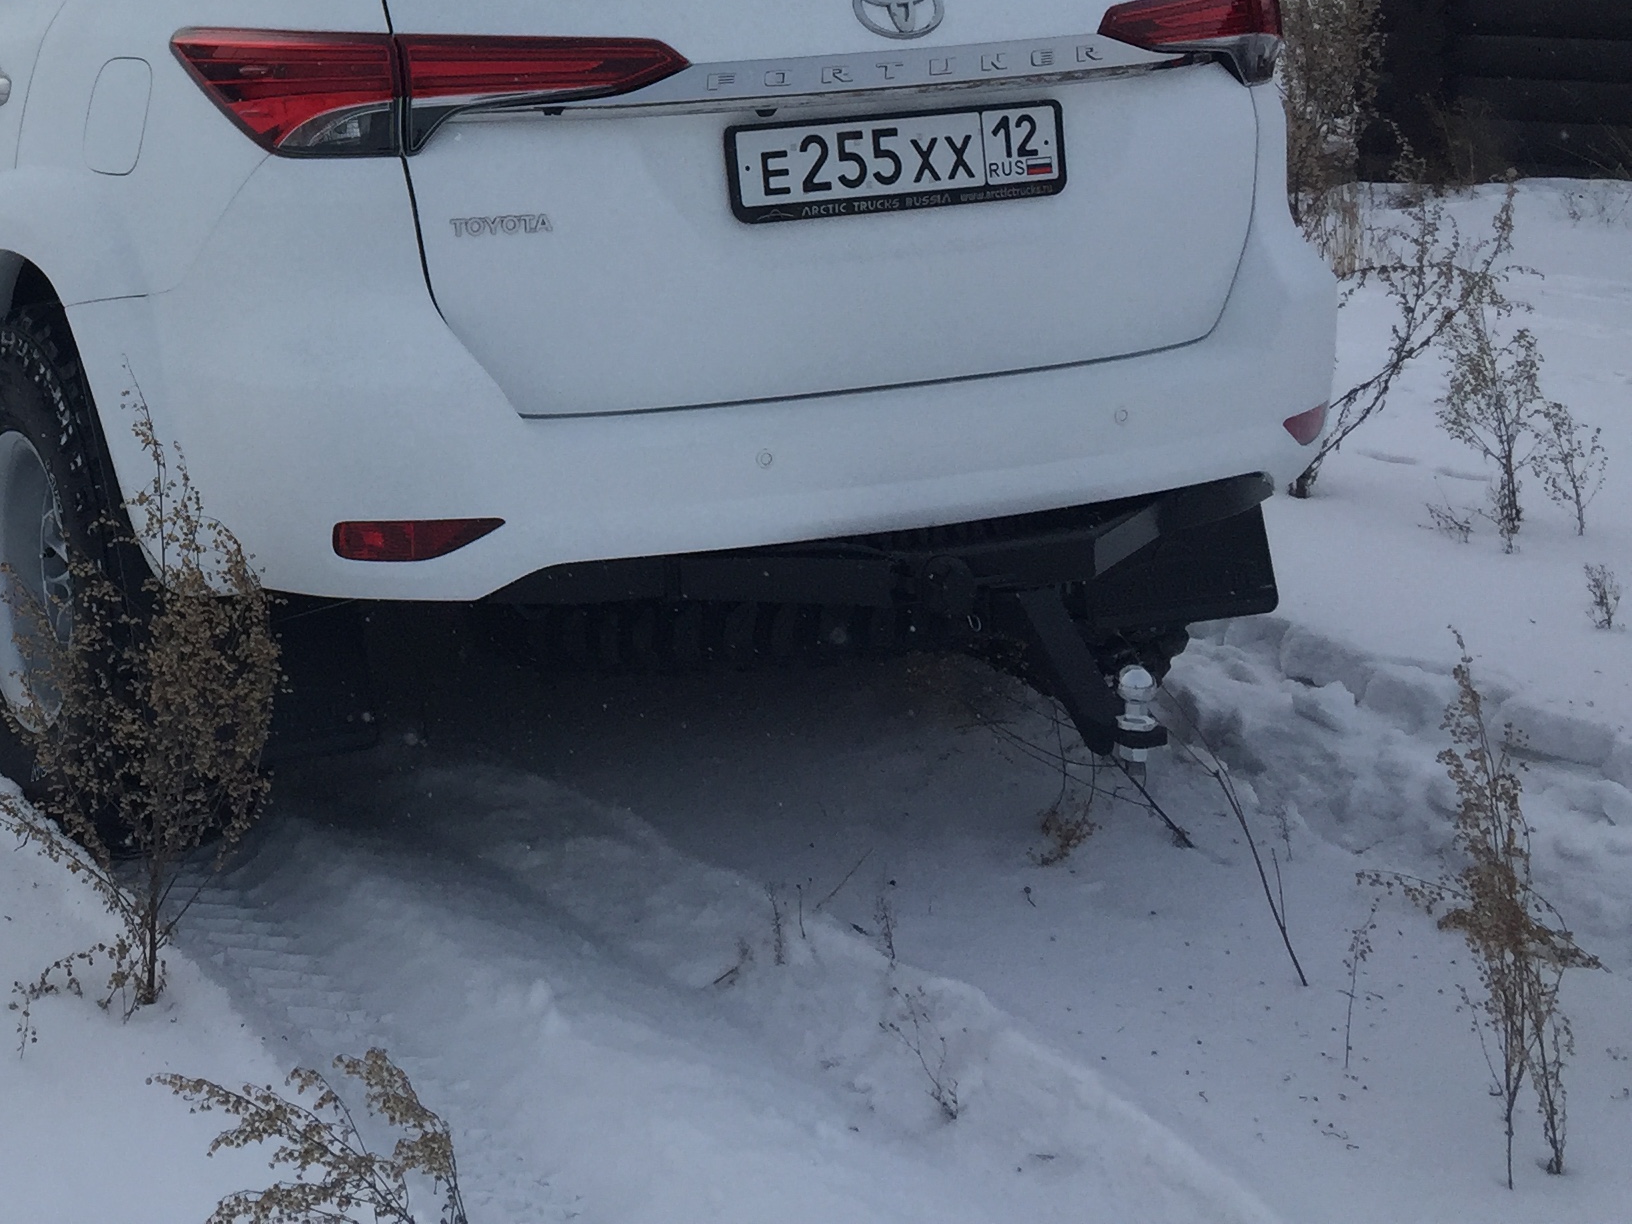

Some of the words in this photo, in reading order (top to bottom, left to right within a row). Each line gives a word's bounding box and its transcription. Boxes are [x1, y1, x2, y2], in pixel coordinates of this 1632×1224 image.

[707, 45, 1103, 90] FORTUNER
[990, 114, 1038, 158] 12
[760, 127, 976, 195] E255XX
[988, 159, 1025, 177] RUS
[801, 203, 848, 217] ARCTIC
[853, 198, 900, 213] TRUCKS
[905, 192, 952, 207] RUSSIA
[449, 213, 553, 237] TOYOTA
